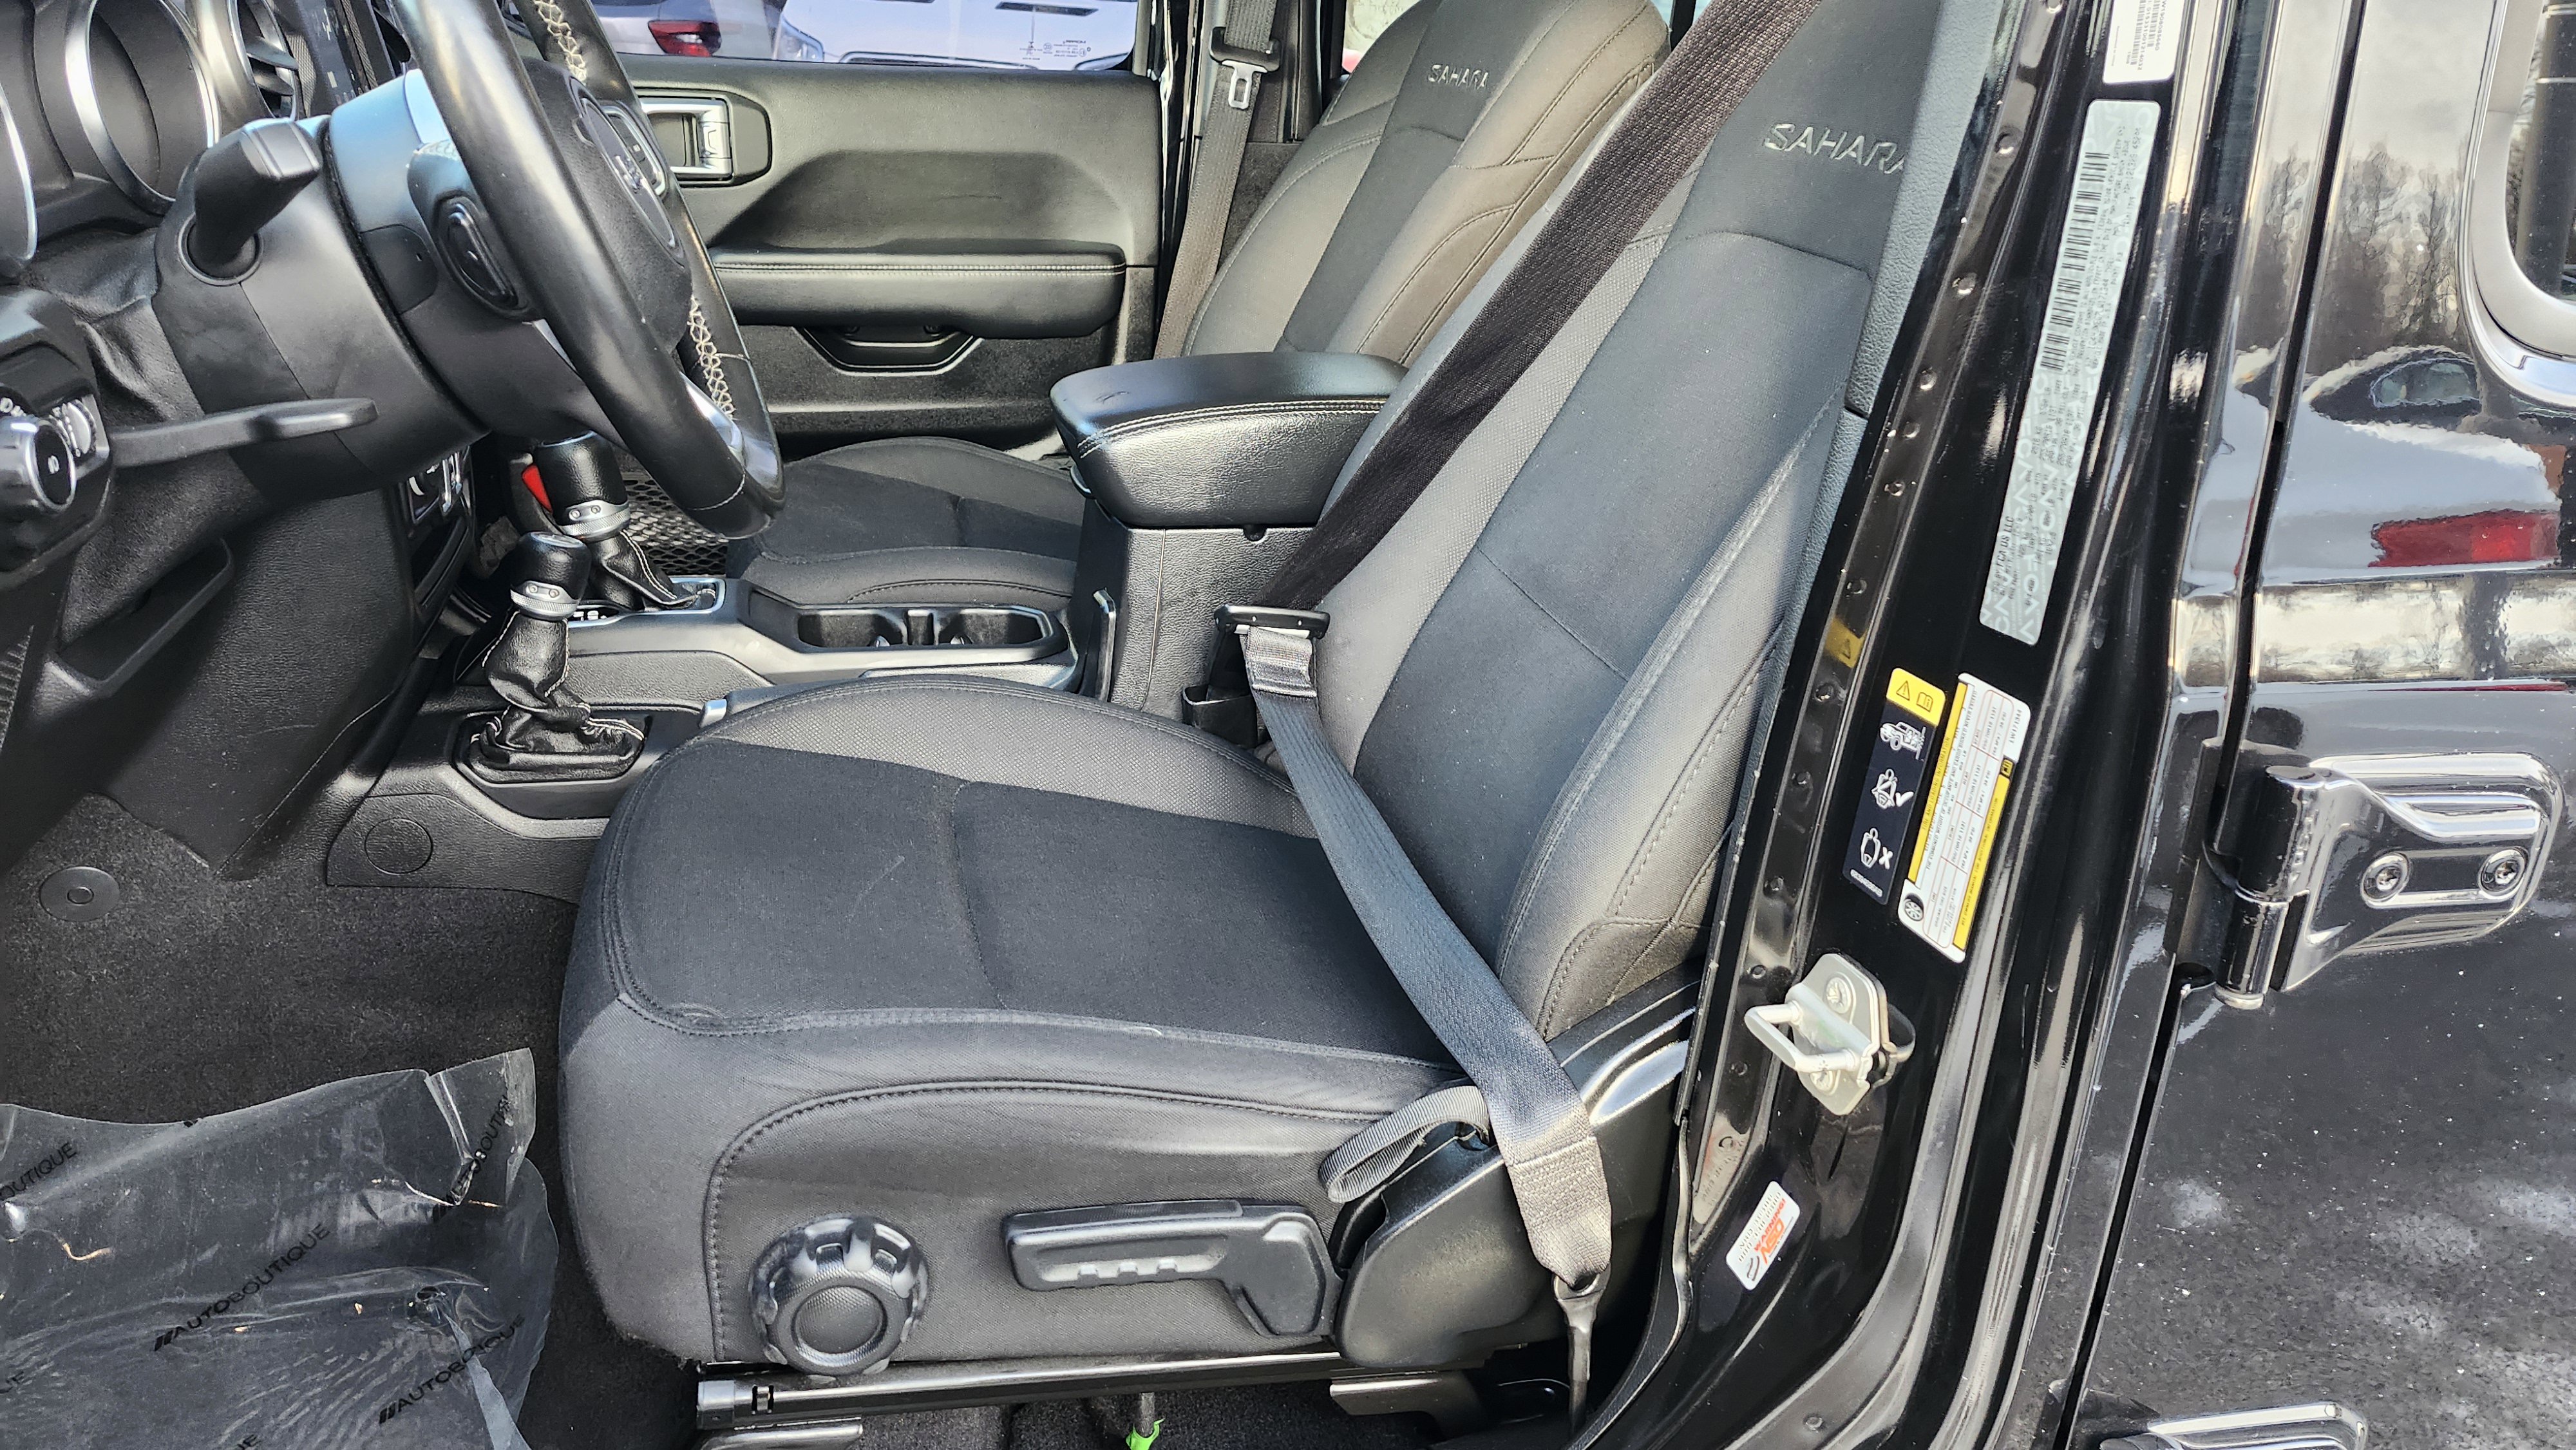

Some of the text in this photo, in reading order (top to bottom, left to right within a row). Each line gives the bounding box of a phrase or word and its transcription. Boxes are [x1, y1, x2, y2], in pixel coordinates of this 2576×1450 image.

[1427, 64, 1489, 90] SAHARA
[2003, 514, 2014, 533] LLC
[2000, 534, 2009, 548] US
[1995, 549, 2006, 567] FCA
[1929, 776, 1940, 802] LOADING
[1936, 735, 1951, 777] INFORMATION
[1754, 1198, 1786, 1252] WARNING!
